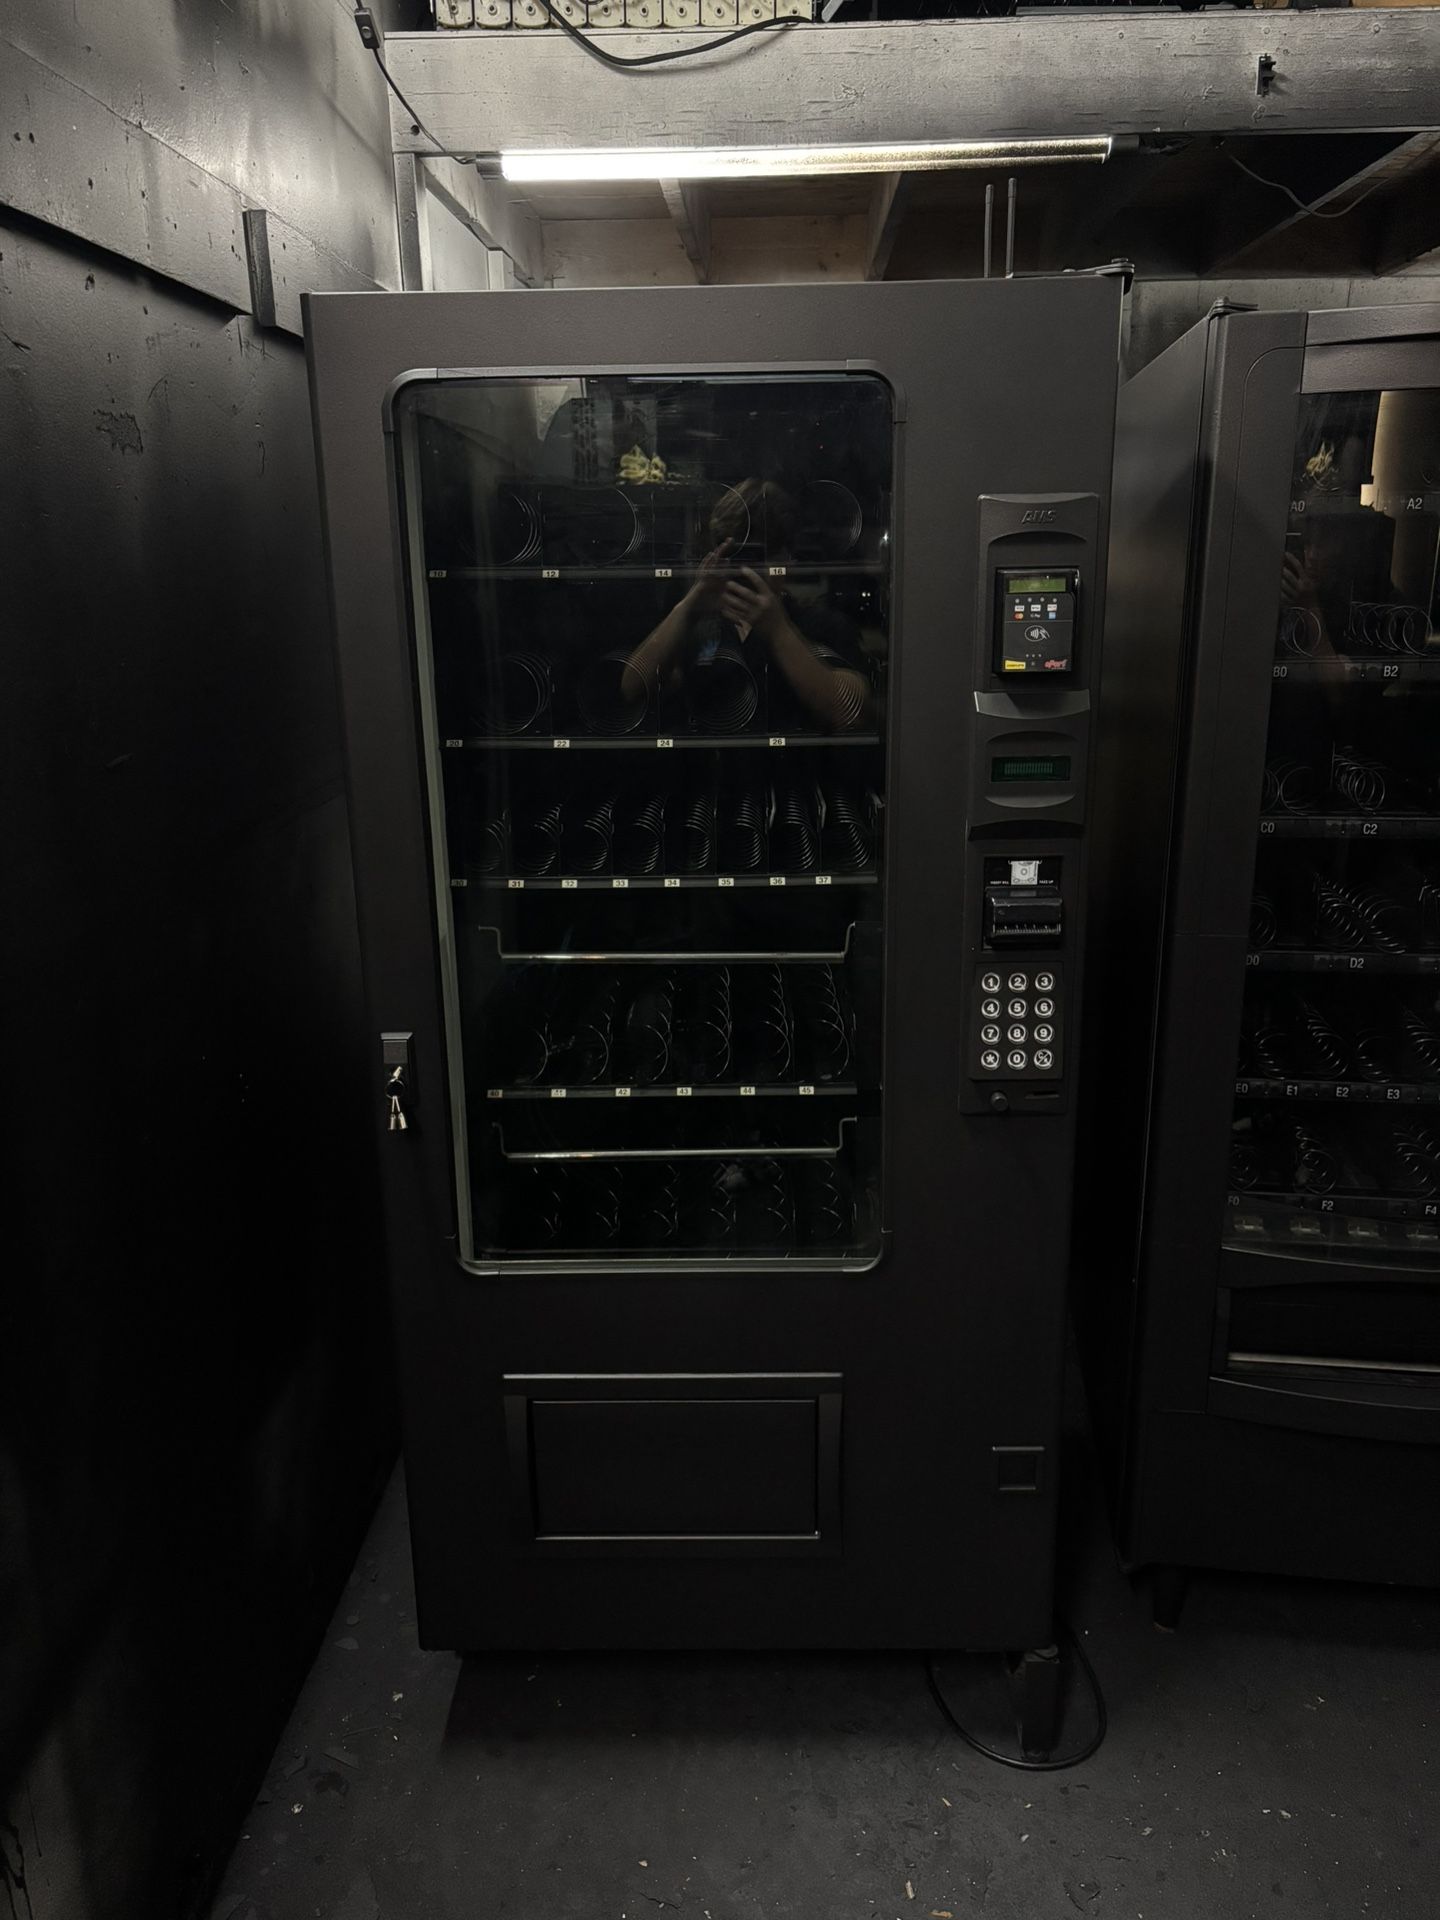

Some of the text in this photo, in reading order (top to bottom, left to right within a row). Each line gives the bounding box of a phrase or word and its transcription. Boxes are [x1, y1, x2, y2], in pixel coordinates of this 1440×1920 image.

[1290, 500, 1306, 512] A0
[1406, 497, 1423, 510] A2
[1383, 665, 1399, 677] B2
[1260, 822, 1275, 834] C0
[1362, 823, 1378, 835] C2
[1349, 957, 1365, 969] D2
[1235, 1083, 1249, 1094] E0
[1286, 1085, 1298, 1096] E1
[1335, 1086, 1350, 1098] E2
[1386, 1088, 1401, 1100] E3
[1227, 1195, 1240, 1206] F0
[1321, 1200, 1334, 1211] F2
[1424, 1205, 1437, 1216] F4
